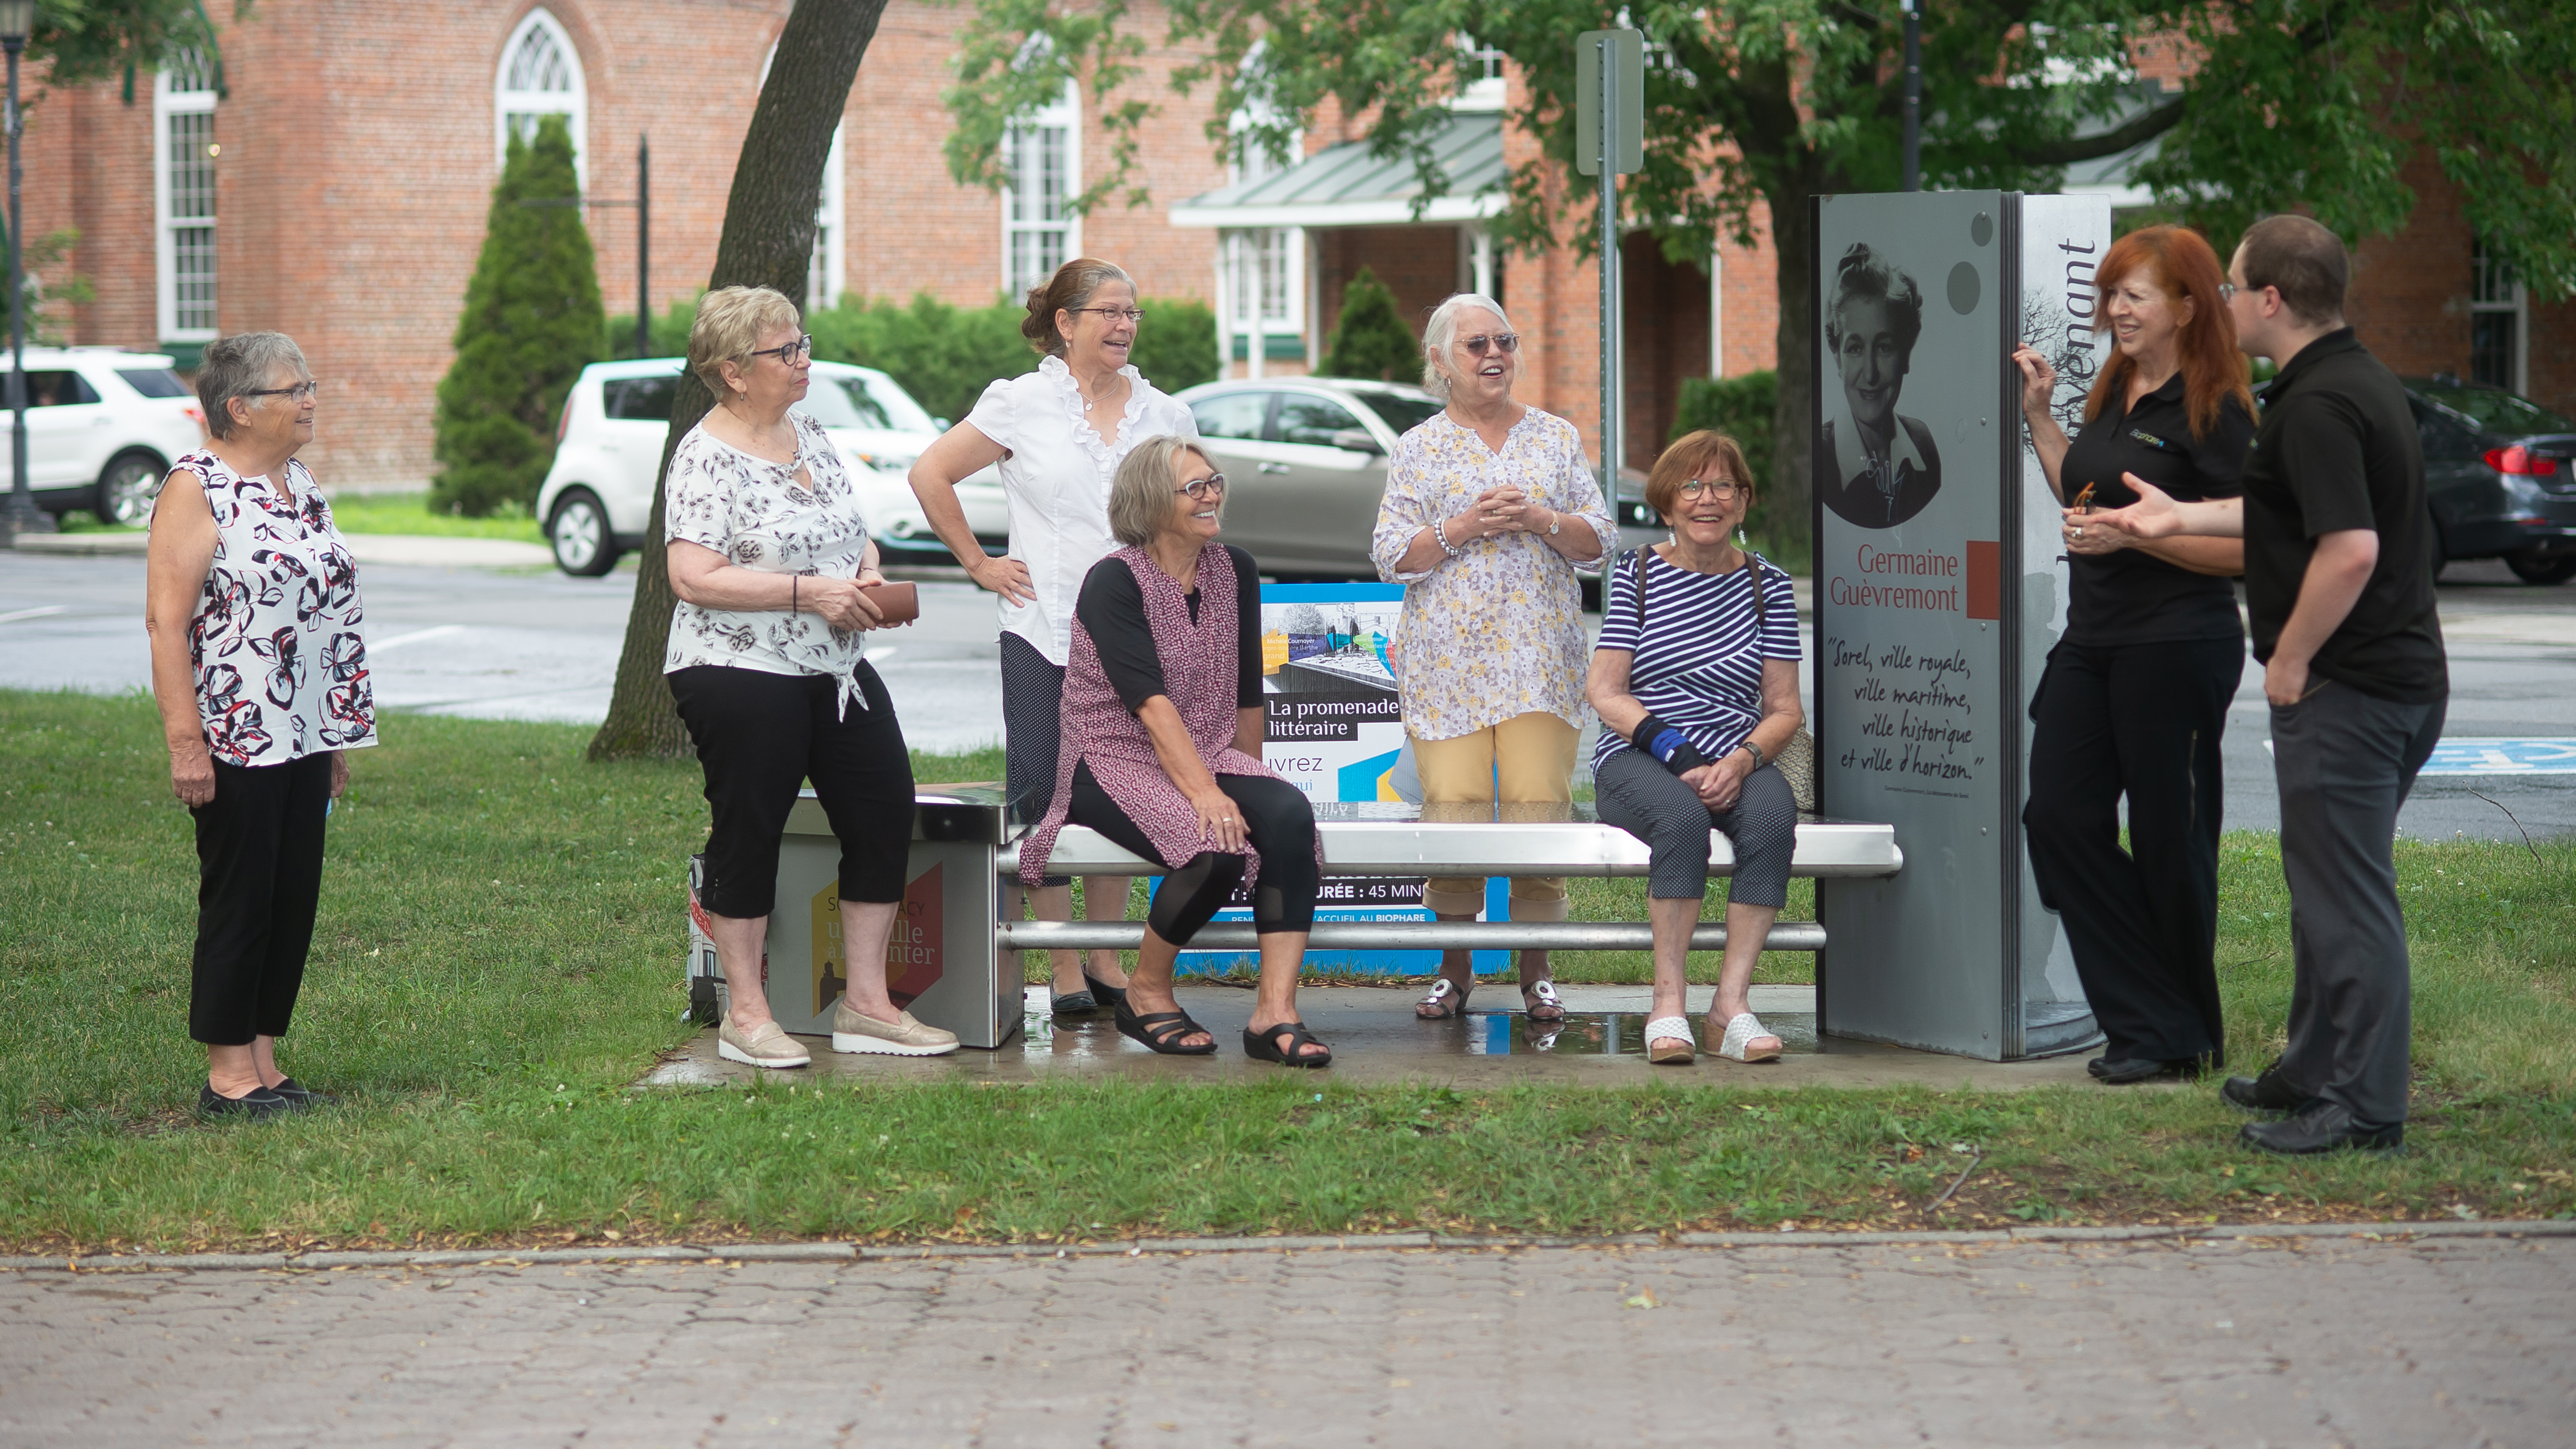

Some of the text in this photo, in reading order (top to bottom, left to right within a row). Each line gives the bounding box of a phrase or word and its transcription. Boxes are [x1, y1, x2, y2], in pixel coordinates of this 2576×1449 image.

[2058, 237, 2096, 444] rvenant
[1858, 543, 1958, 577] Germaine
[1830, 576, 1960, 612] Guèvremont
[1263, 652, 1285, 661] grand
[1828, 636, 1971, 686] "Sorel, ville royale,
[1269, 698, 1399, 719] La promenade
[1854, 677, 1971, 715] ville maritime,
[1269, 720, 1348, 736] littéraire
[1862, 708, 1974, 755] ville historique
[1841, 748, 1858, 769] et
[1861, 747, 1894, 772] ville
[1369, 885, 1386, 897] 45
[1375, 914, 1426, 922] BIOPHARE
